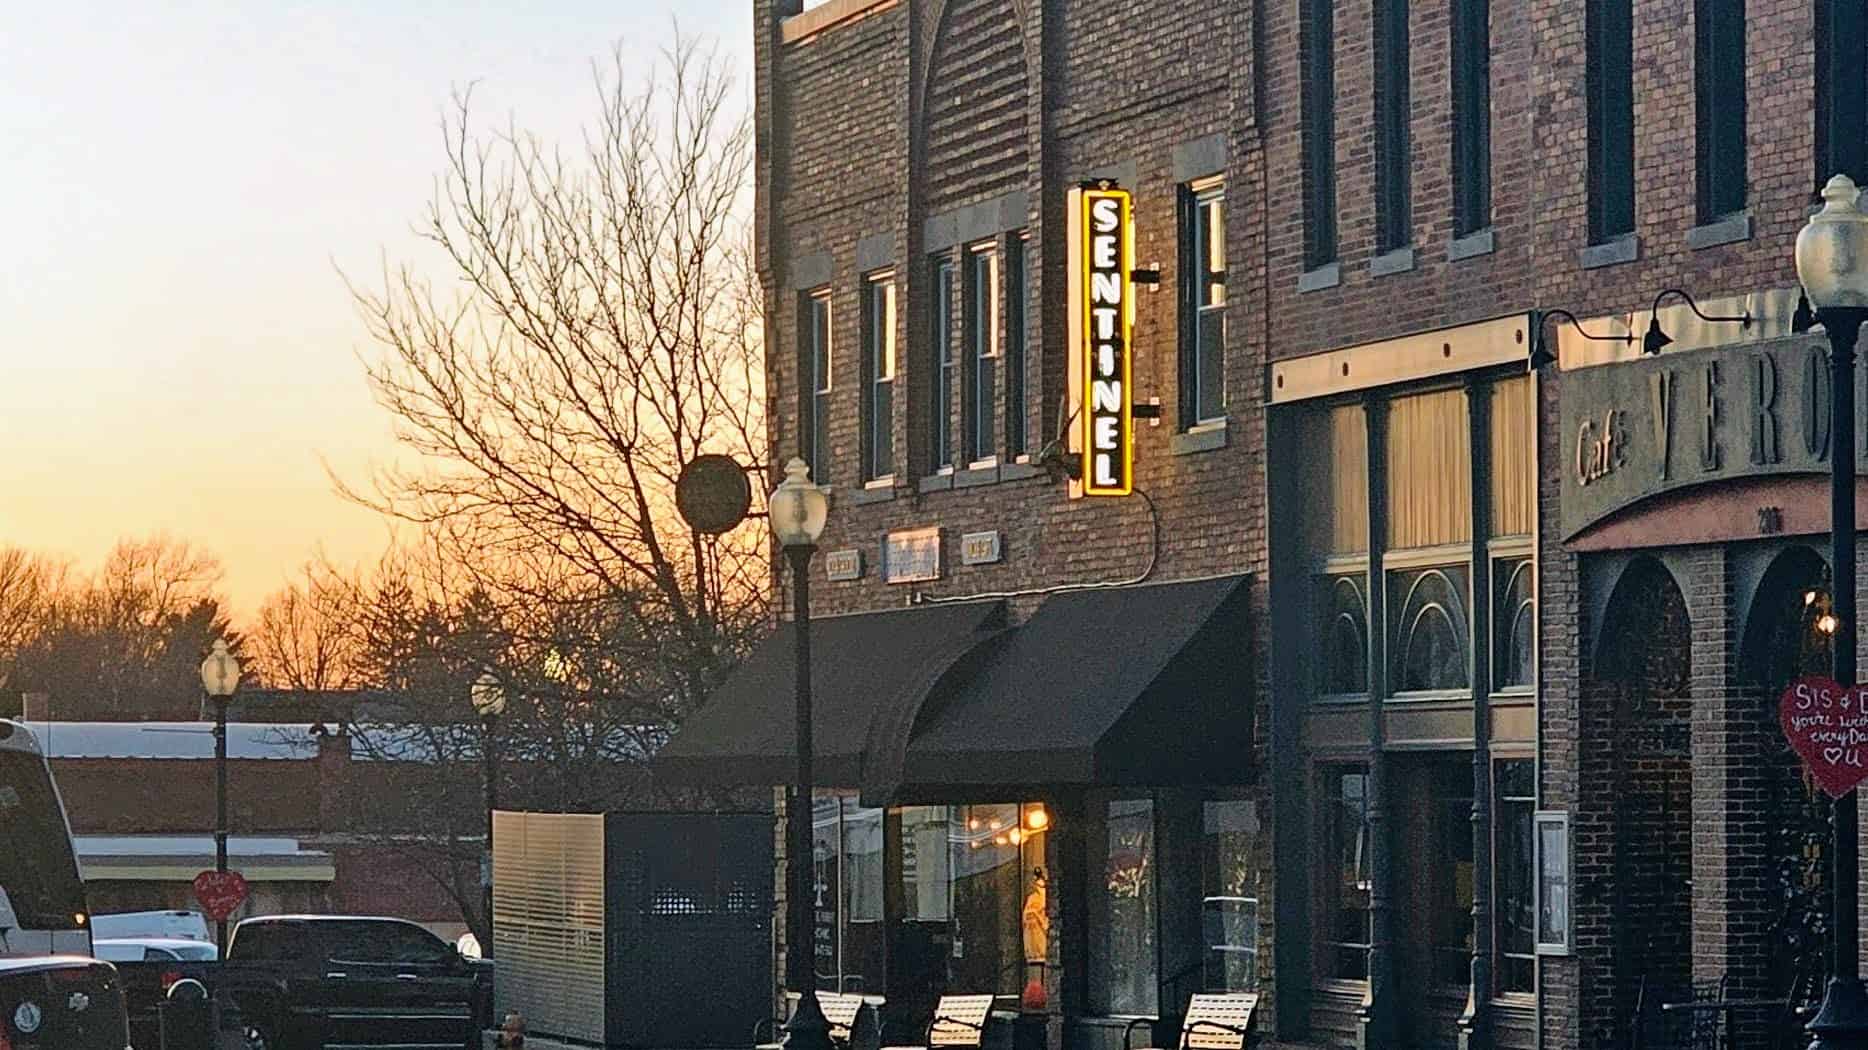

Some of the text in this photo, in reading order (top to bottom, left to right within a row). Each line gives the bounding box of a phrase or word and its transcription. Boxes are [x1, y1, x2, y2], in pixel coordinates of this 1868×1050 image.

[1092, 199, 1121, 486] SENTINEL
[1576, 345, 1868, 486] Café VERO
